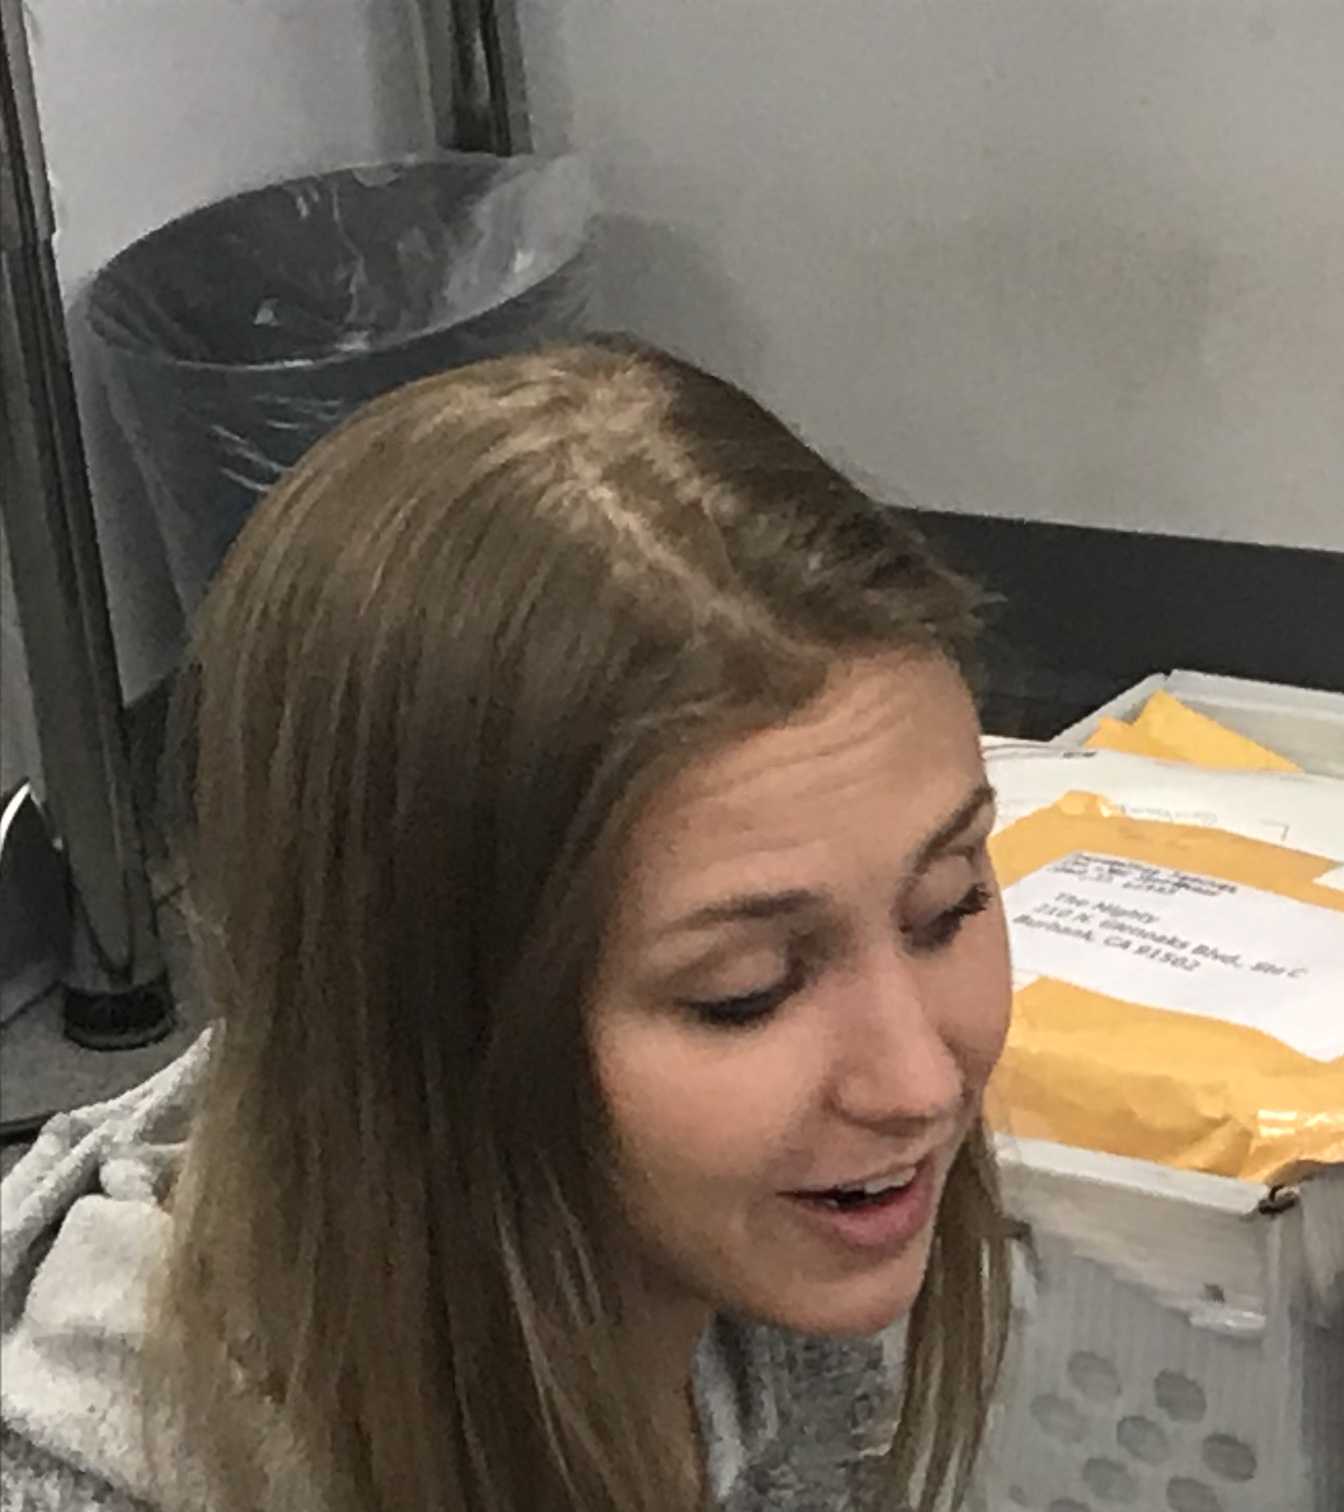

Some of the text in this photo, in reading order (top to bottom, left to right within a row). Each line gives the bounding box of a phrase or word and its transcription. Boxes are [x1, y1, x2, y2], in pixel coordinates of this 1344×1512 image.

[1053, 891, 1161, 925] The Mighty
[1102, 934, 1133, 951] CA
[1132, 945, 1202, 974] 91502
